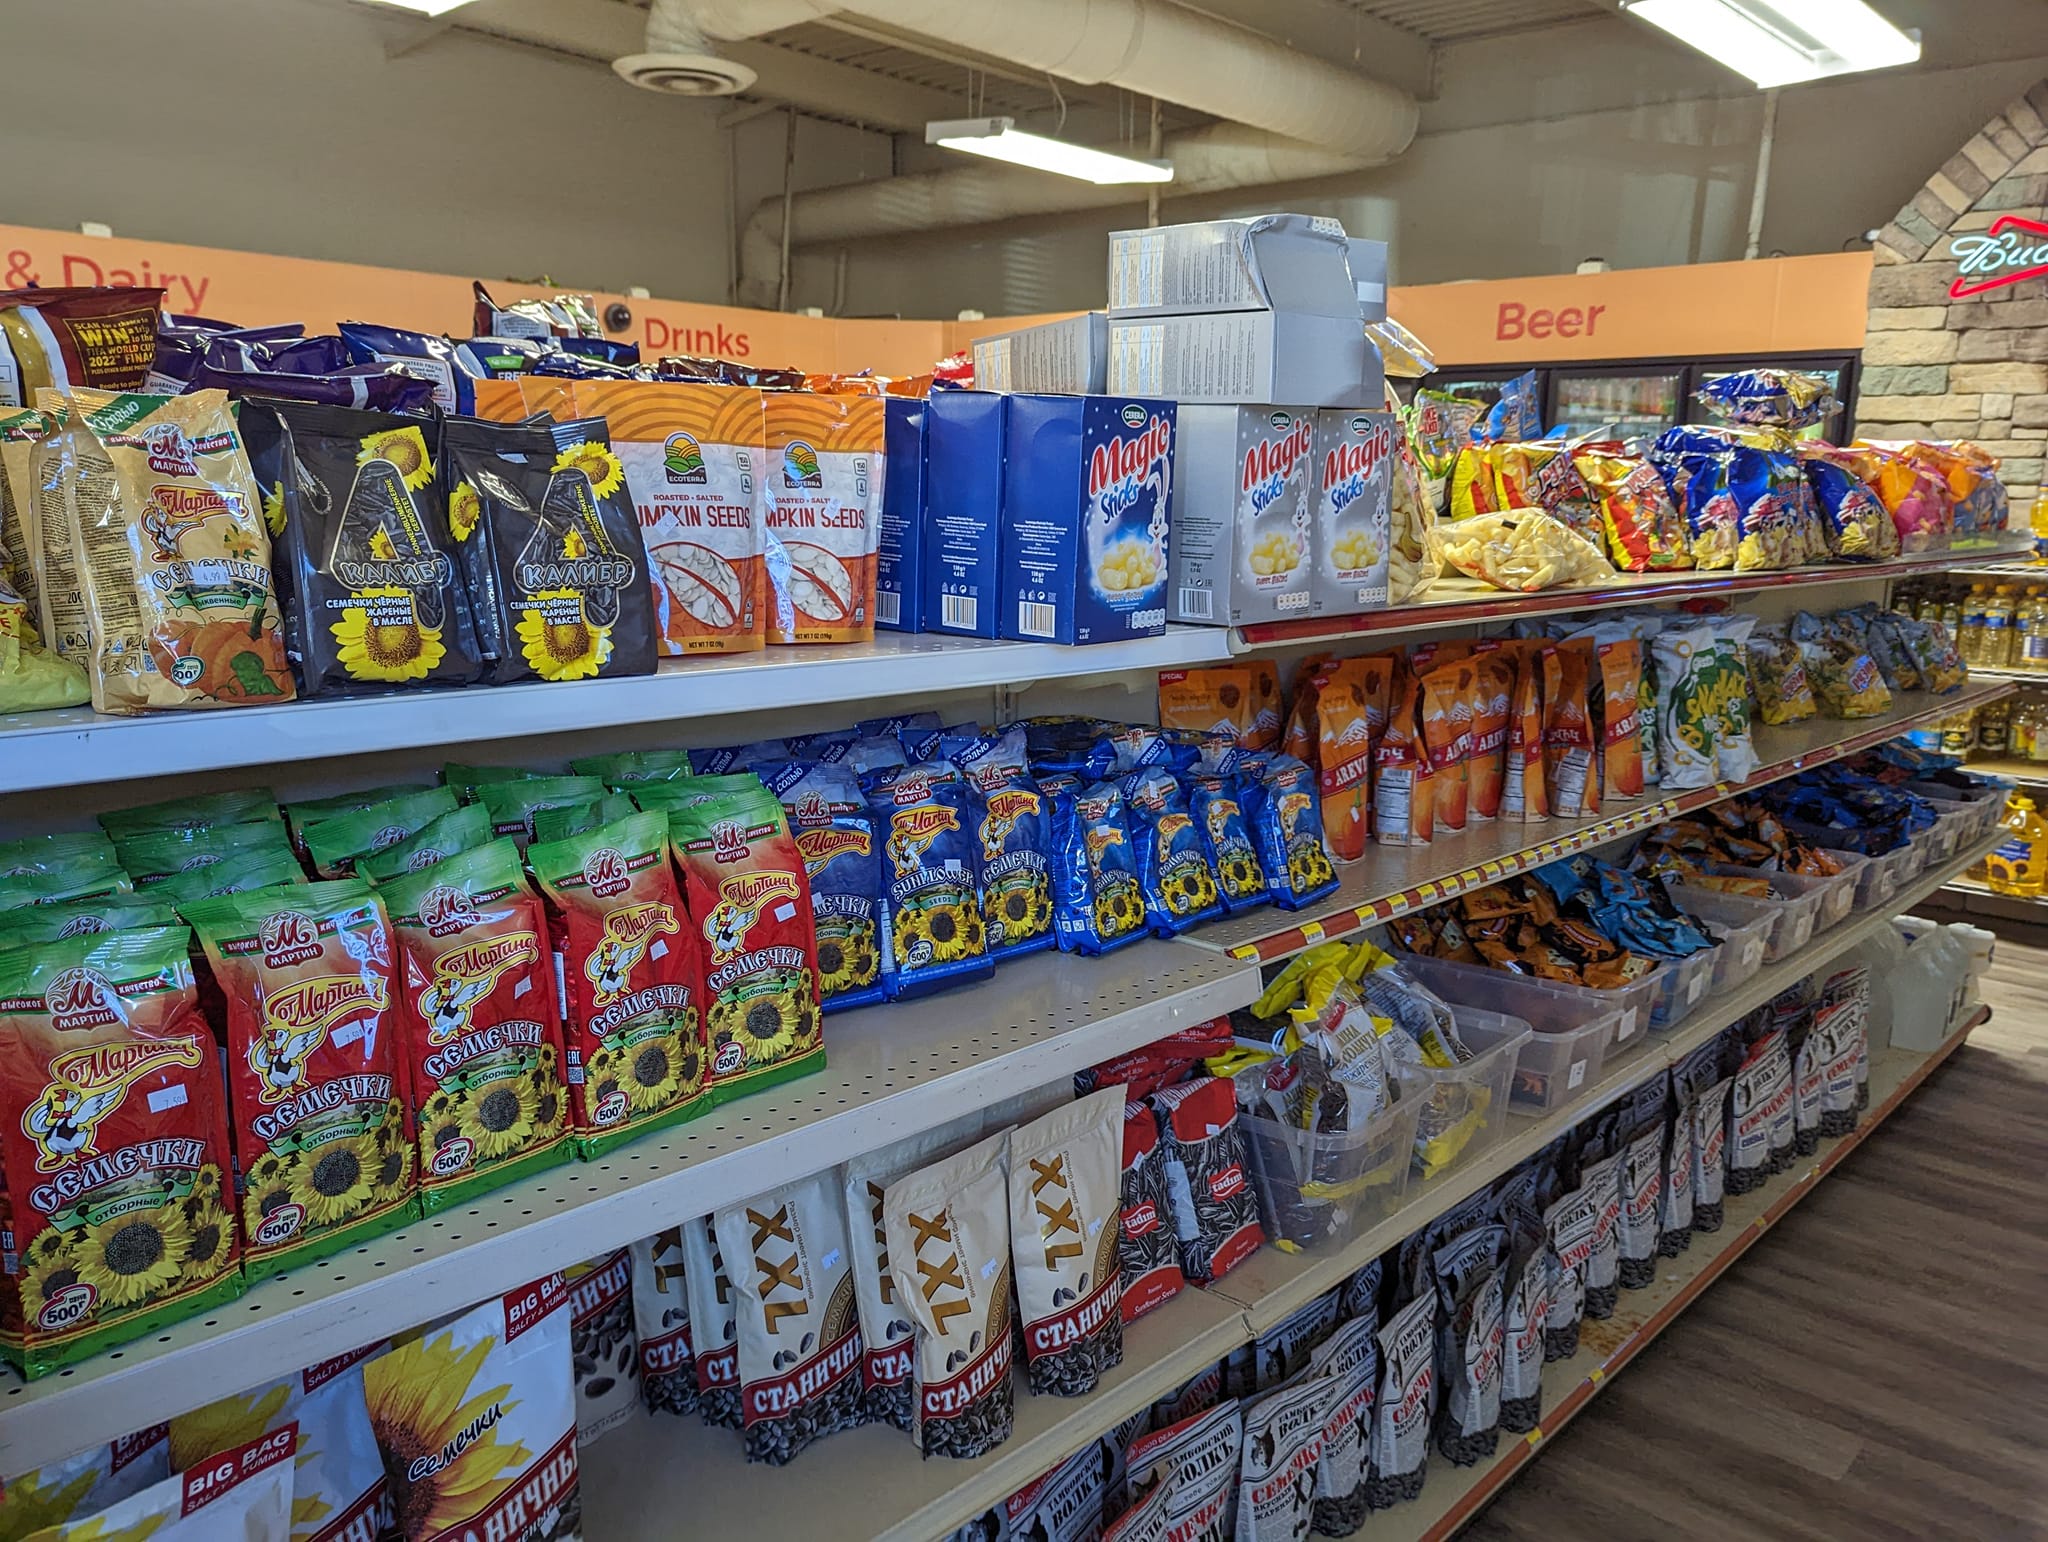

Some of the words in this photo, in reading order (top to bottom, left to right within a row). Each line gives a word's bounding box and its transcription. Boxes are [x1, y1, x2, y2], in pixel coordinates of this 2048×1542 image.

[1495, 302, 1605, 341] Beer
[78, 328, 131, 347] WIN
[108, 344, 139, 354] WORLD
[645, 318, 750, 357] Drinks
[153, 459, 194, 475] МАРТИН
[1089, 414, 1169, 496] Magic
[1243, 418, 1312, 492] Magic
[1322, 425, 1390, 490] Magic
[668, 475, 706, 484] ECOTERRA
[786, 480, 821, 488] ECOTERRA
[653, 494, 690, 502] ROASTED
[695, 494, 724, 502] SALTED
[1100, 476, 1142, 525] Sticks
[1251, 472, 1285, 517] Sticks
[1331, 475, 1364, 514] Sticks
[707, 506, 750, 530] SEEDS
[340, 560, 449, 585] КАЛИБР
[523, 562, 630, 588] КАЛИБР
[326, 597, 373, 609] СЕМЕЧКИ
[374, 596, 411, 607] ЧЁРНЫЕ
[366, 606, 412, 617] ЖАРЕНЫЕ
[510, 600, 547, 609] СЕМЕЧКИ
[541, 607, 580, 617] ЖАРЕНЫЕ
[373, 617, 380, 627] В
[382, 615, 413, 627] МАСЛЕ
[556, 615, 581, 625] МАСЛЕ
[1160, 673, 1185, 681] SPECIAL
[897, 790, 928, 804] MARTIN
[801, 816, 832, 826] МАРТИН
[912, 810, 955, 833] Martin
[717, 849, 747, 863] МАРТИН
[809, 831, 868, 857] Мартина
[596, 880, 628, 896] МАРТИН
[733, 875, 792, 908] Мартина
[270, 947, 319, 967] МАРТИН
[461, 936, 537, 978] Мартина
[708, 946, 804, 993] СЕМЕЧКИ
[119, 979, 161, 994] КАЧЕСТВО
[741, 985, 780, 1001] отборные
[59, 1011, 114, 1029] МАРТИН
[589, 985, 690, 1036] СЕМЕЧКИ
[424, 1020, 543, 1078] СЕМЕЧКИ
[628, 1028, 668, 1045] отборные
[471, 1067, 519, 1089] отборные
[253, 1075, 393, 1140] СЕМЕЧКИ
[306, 1127, 360, 1149] отборные
[31, 1139, 206, 1214] СЕМЕЧКИ
[94, 1197, 161, 1222] отборные
[1029, 1154, 1084, 1273] XXL
[745, 1204, 809, 1335] XXL
[907, 1207, 972, 1336] XXL
[508, 1295, 538, 1324] BIG
[508, 1313, 537, 1338] SALTY
[407, 1402, 503, 1482] Семечки
[1166, 1422, 1234, 1470] ТАМБОВСКИЙ
[188, 1462, 233, 1498] BIG
[242, 1430, 291, 1468] BAG
[187, 1482, 228, 1513] SALTY
